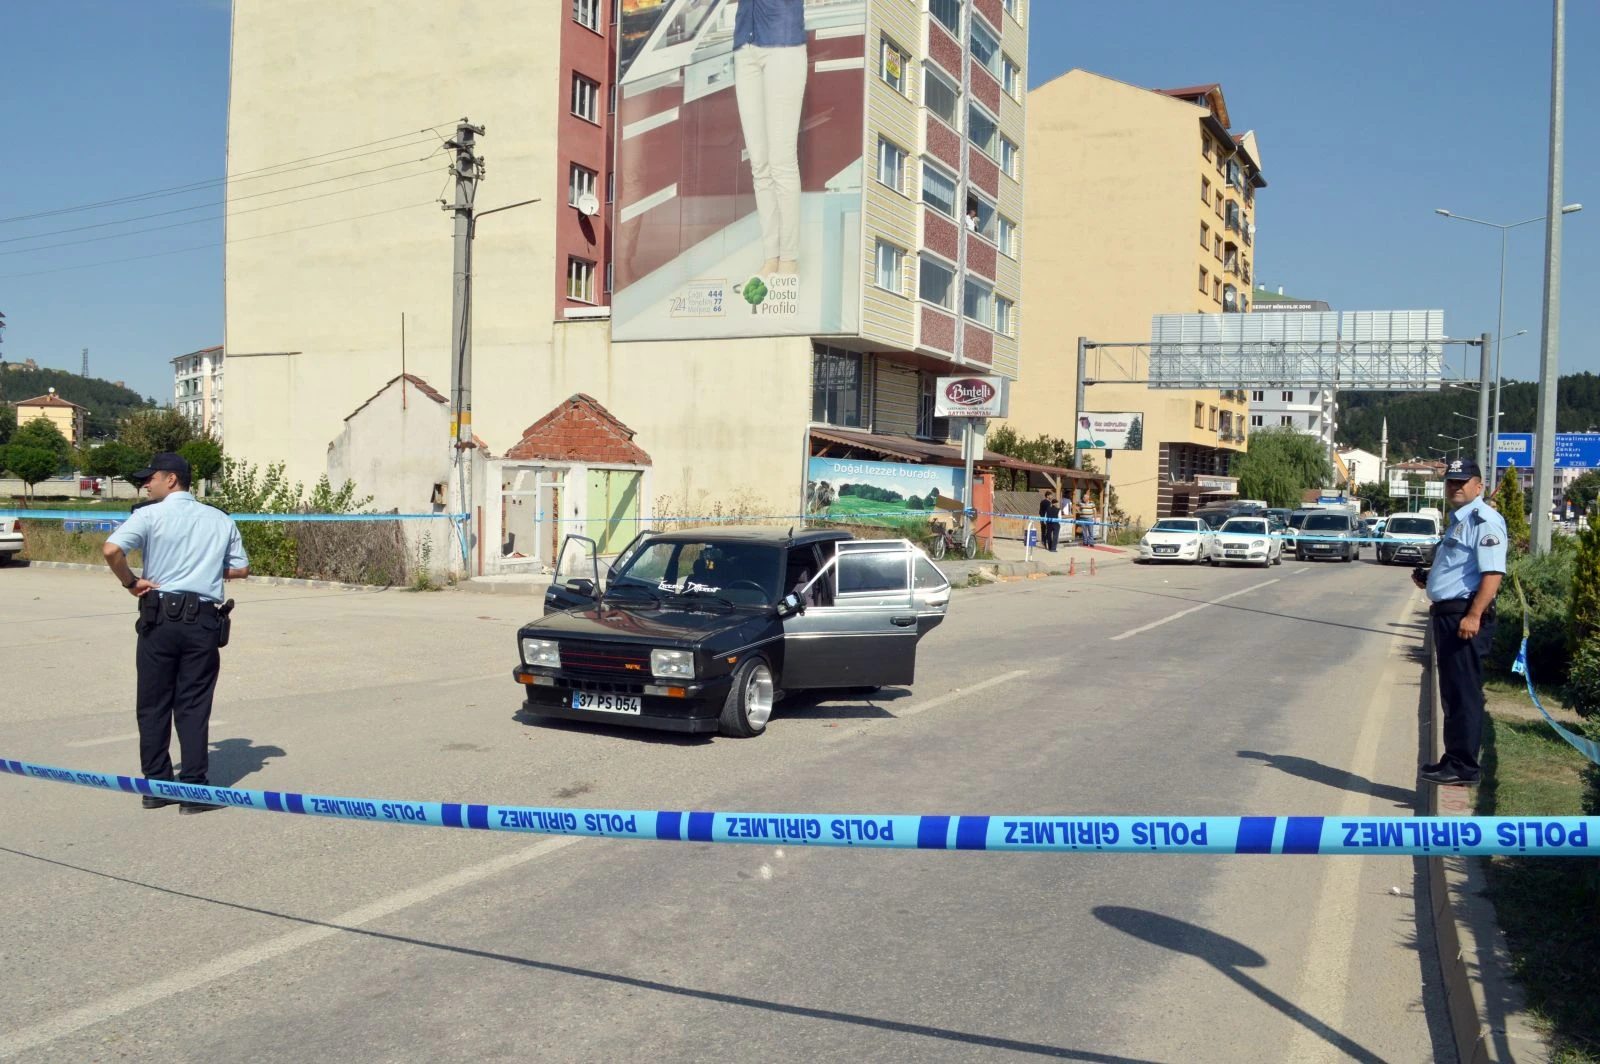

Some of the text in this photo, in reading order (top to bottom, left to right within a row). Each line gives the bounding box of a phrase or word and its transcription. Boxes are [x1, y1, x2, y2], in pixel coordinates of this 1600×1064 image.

[770, 276, 797, 288] Çevre
[769, 290, 797, 300] Dostu
[762, 301, 796, 314] Profilo
[949, 384, 991, 401] Bintelli
[833, 463, 863, 475] Doğal
[865, 464, 897, 477] lezzet
[579, 693, 638, 713] 37 PS 054
